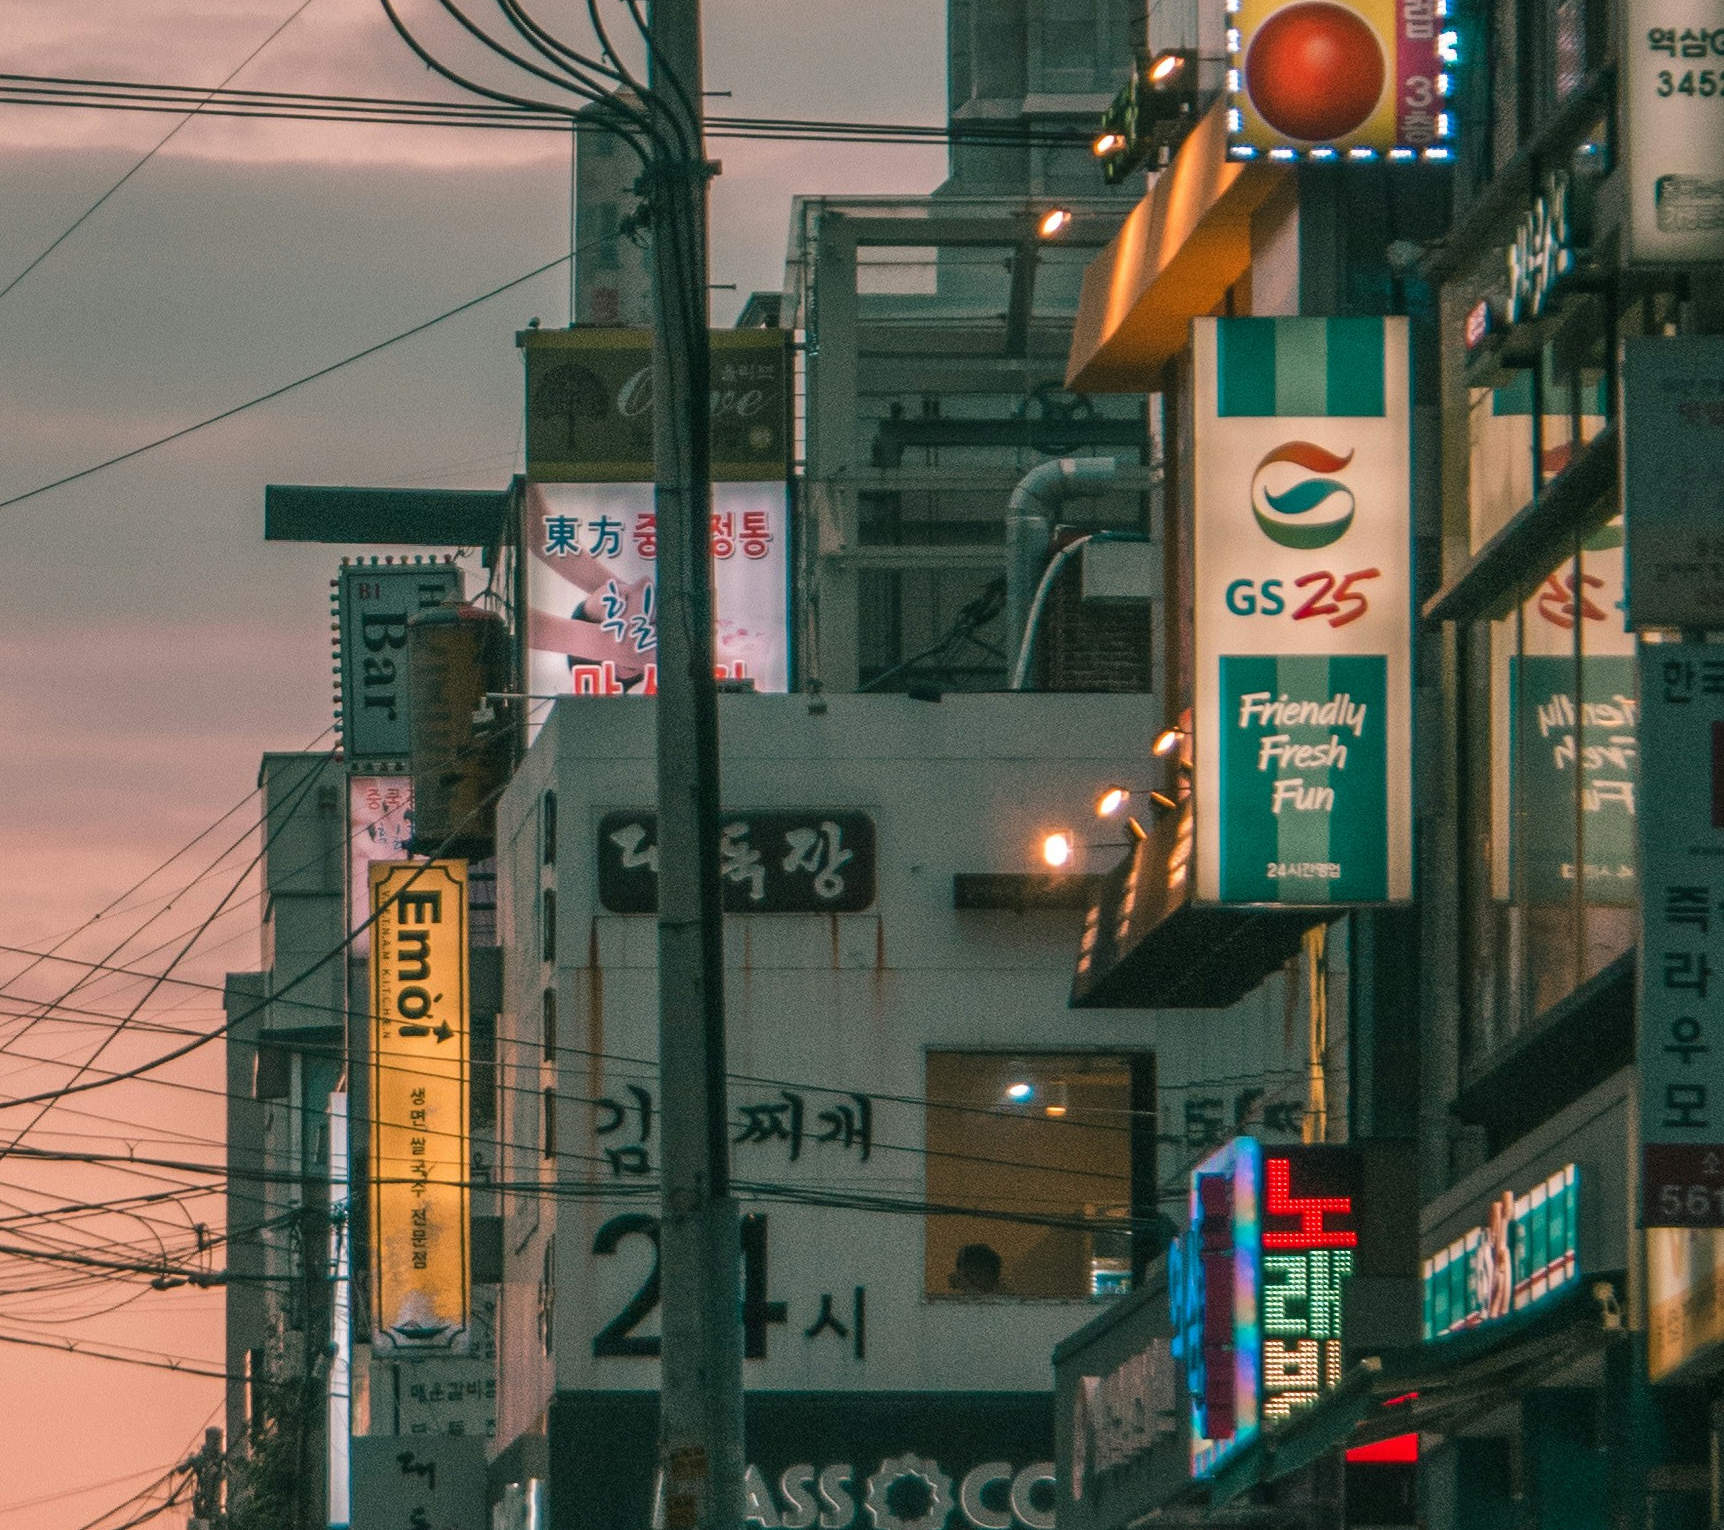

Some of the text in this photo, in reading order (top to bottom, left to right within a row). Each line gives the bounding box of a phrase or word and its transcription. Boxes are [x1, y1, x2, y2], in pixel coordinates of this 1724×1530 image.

[544, 515, 624, 556] 東方
[1225, 567, 1381, 629] GS25
[362, 611, 408, 721] Bar
[1238, 690, 1368, 738] Friendly
[1257, 734, 1348, 772] Fresh
[1271, 777, 1336, 814] Fun
[1262, 1158, 1358, 1420] 노래방
